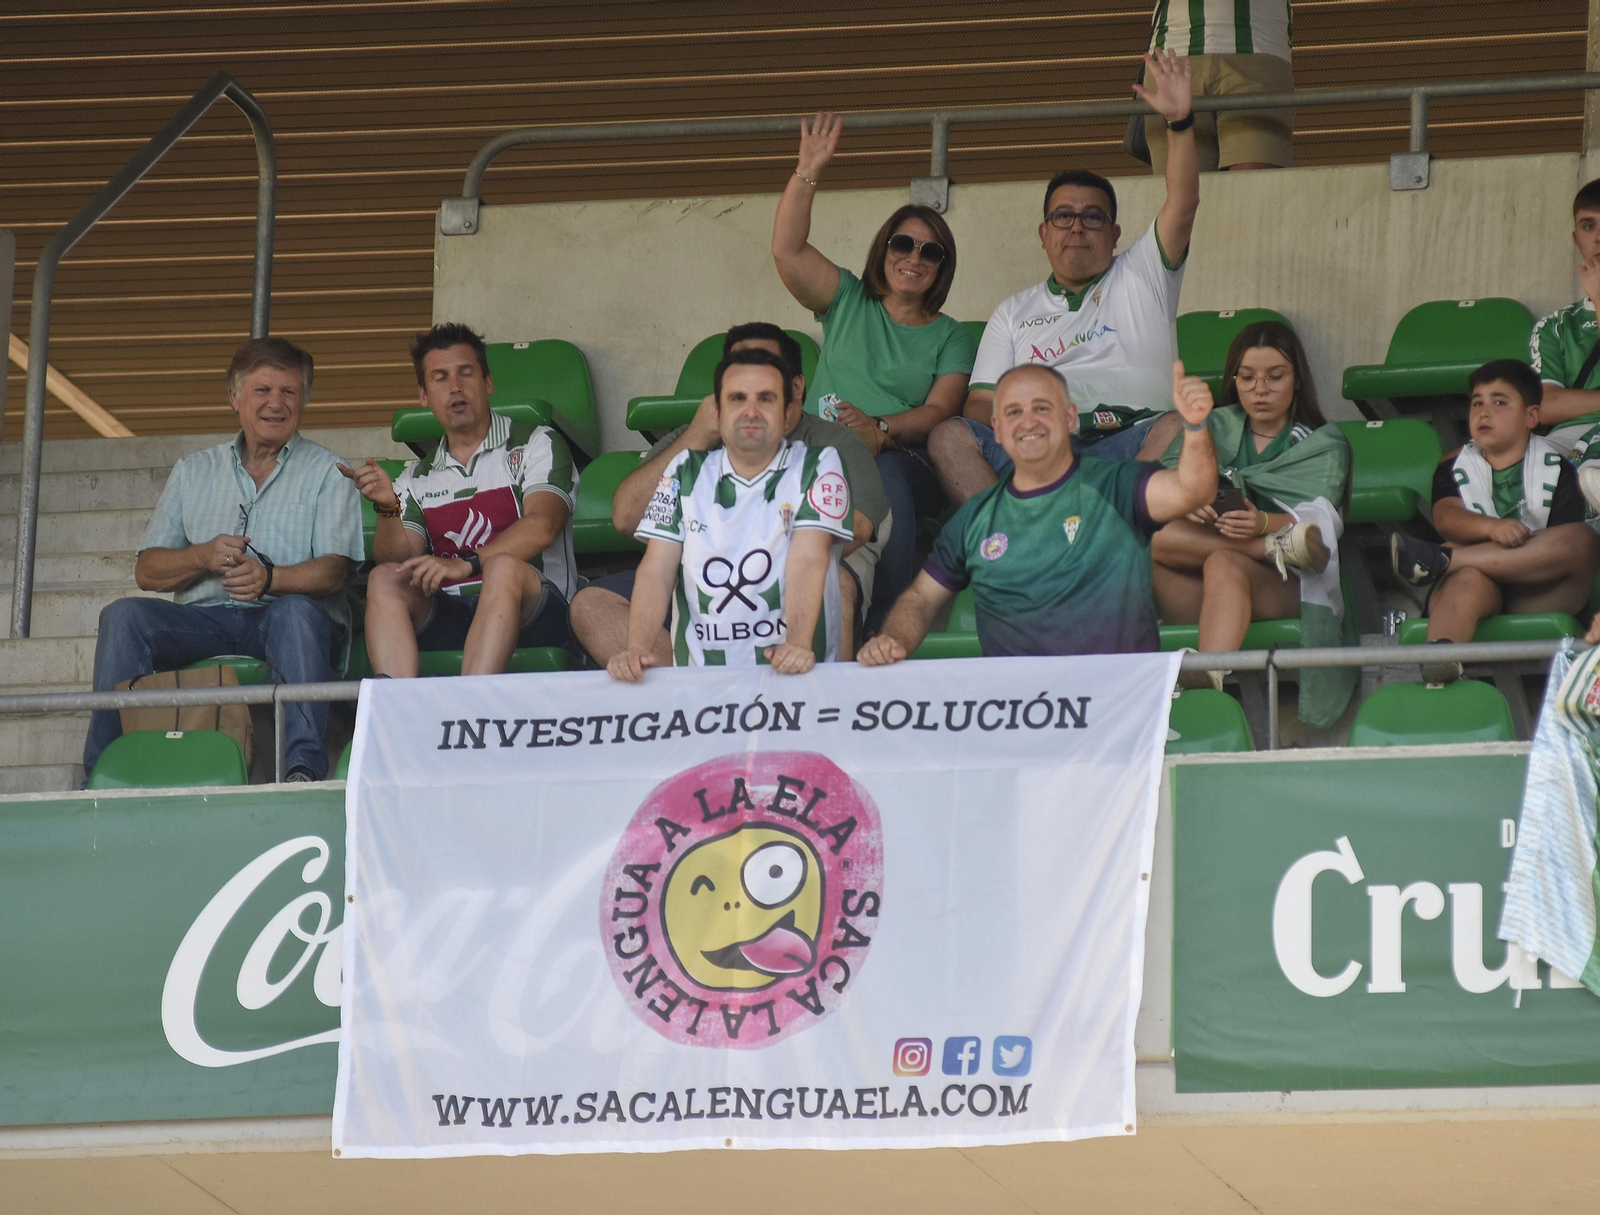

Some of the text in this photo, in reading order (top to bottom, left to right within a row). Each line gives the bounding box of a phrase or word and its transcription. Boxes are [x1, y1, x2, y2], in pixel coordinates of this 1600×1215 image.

[437, 693, 805, 750] INVESTIGACIÓN
[852, 691, 1092, 732] SOLUCIÓN
[611, 774, 881, 1039] SACA LA LENGUA A LA ELA
[1273, 835, 1586, 998] Cru
[432, 1083, 1032, 1128] WWW.SACALENGUAELA.COM
